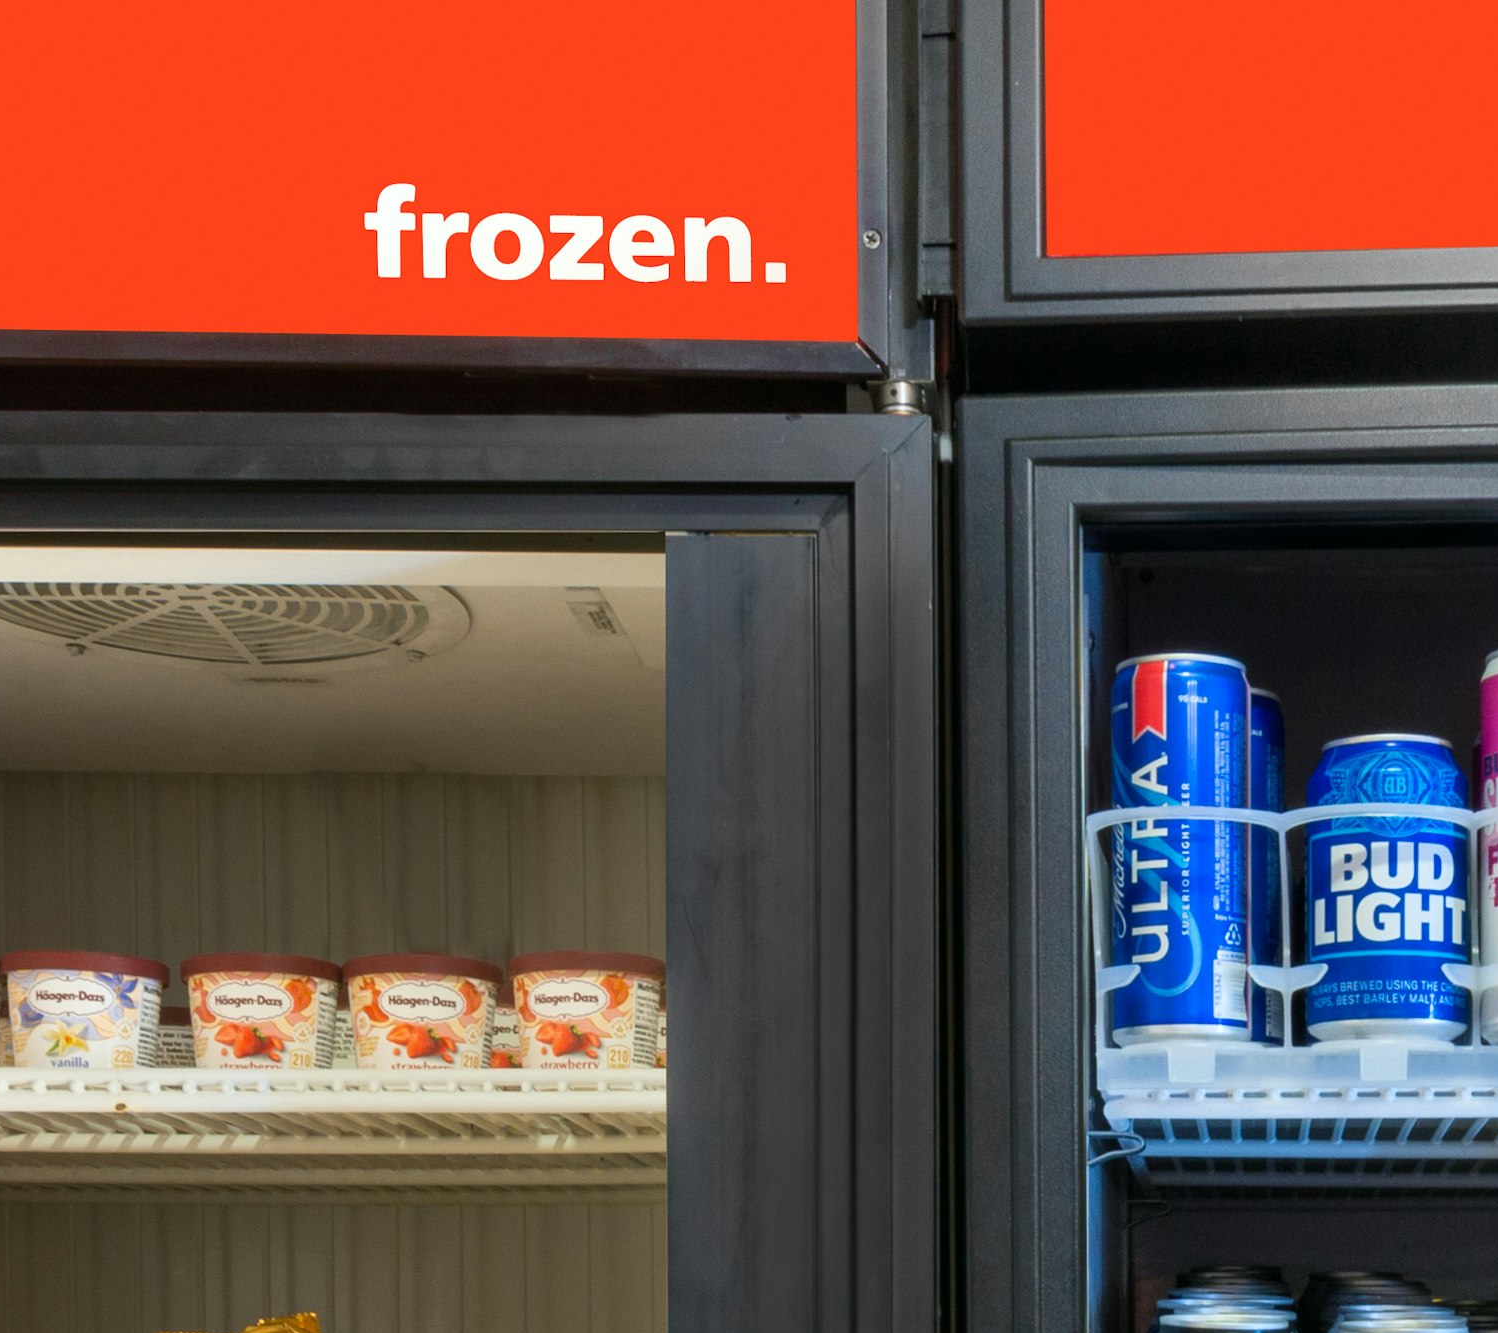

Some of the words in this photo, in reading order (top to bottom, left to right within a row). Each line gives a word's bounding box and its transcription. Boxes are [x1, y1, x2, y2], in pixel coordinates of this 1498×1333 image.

[364, 183, 786, 283] frozen.
[1180, 822, 1191, 862] LIGHT
[1331, 842, 1454, 889] BUD
[1180, 866, 1191, 936] SUPERIOR
[1314, 894, 1465, 944] LIGHT
[35, 990, 105, 1004] Häagen-Dazs
[215, 994, 283, 1009] Häagen-Dazs
